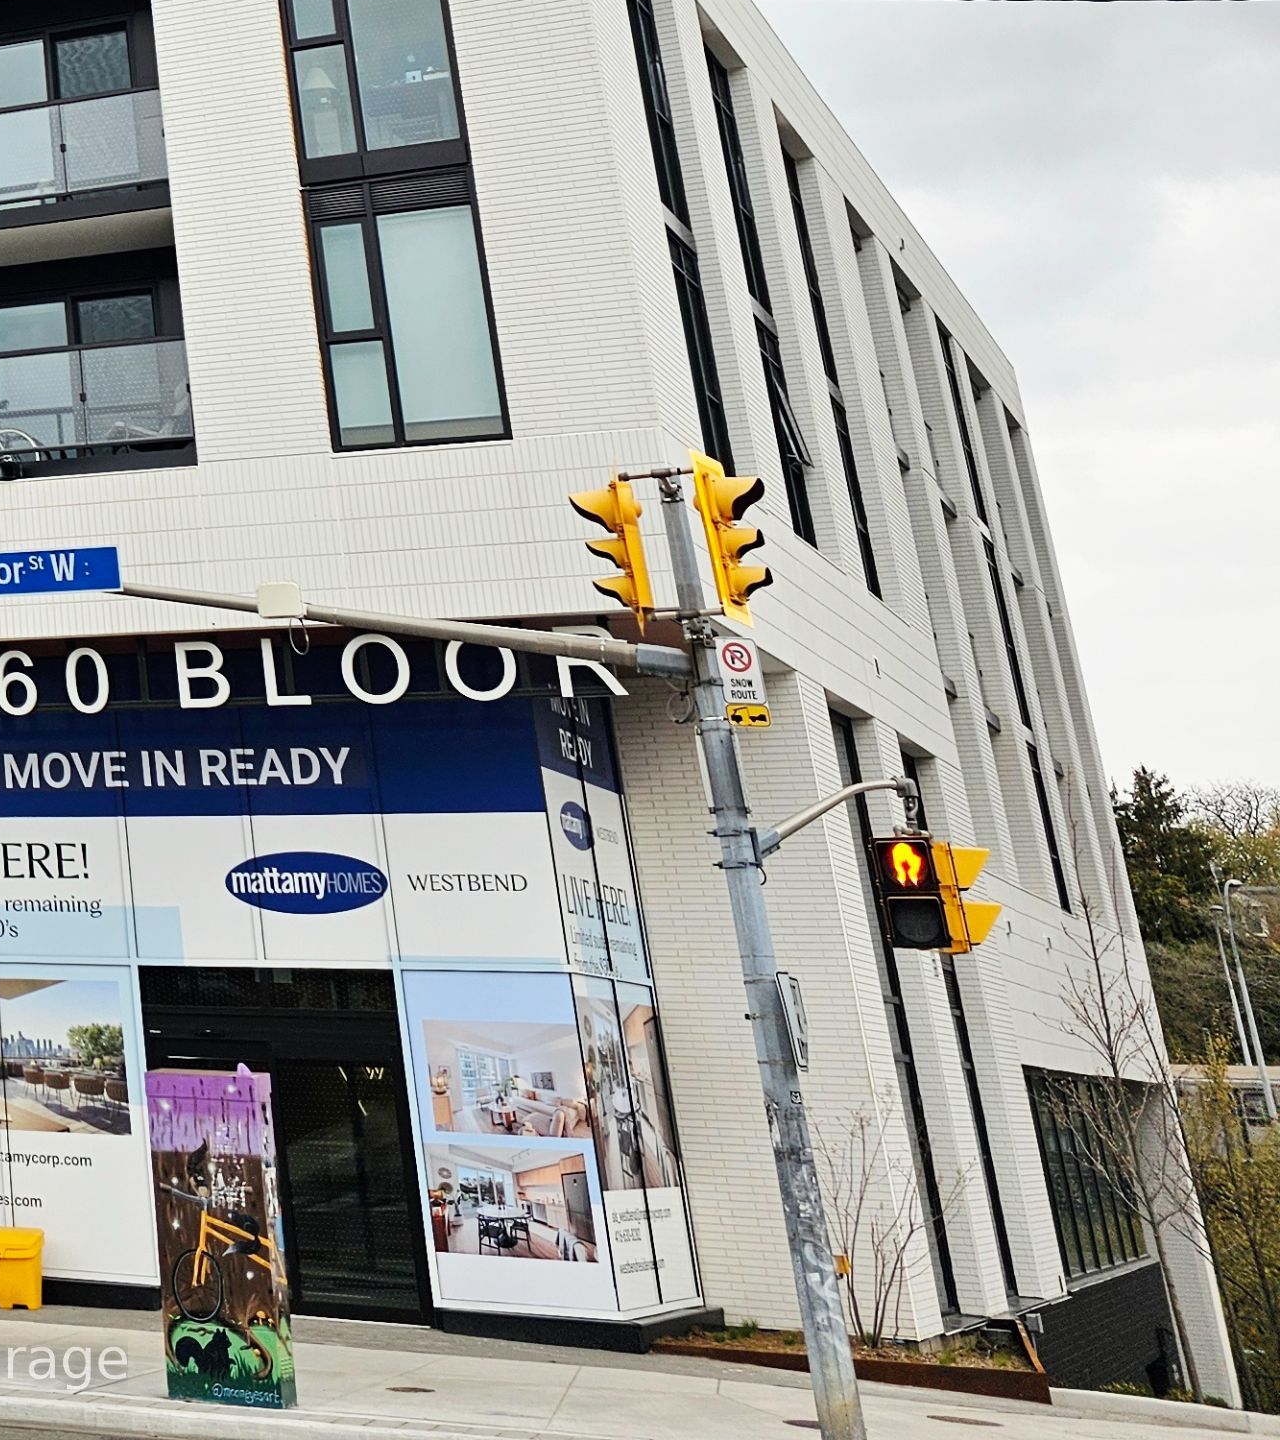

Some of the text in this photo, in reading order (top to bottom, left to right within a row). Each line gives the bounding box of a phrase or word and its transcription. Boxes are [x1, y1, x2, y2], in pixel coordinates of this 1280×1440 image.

[29, 556, 44, 571] St
[51, 553, 76, 582] W
[174, 625, 630, 709] BLOOR
[730, 678, 754, 688] SNOW
[730, 690, 758, 700] ROUTE
[3, 747, 351, 789] MOVE IN READY
[407, 873, 529, 893] WESTBEND
[4, 896, 103, 918] remaining
[562, 874, 593, 919] LIVE
